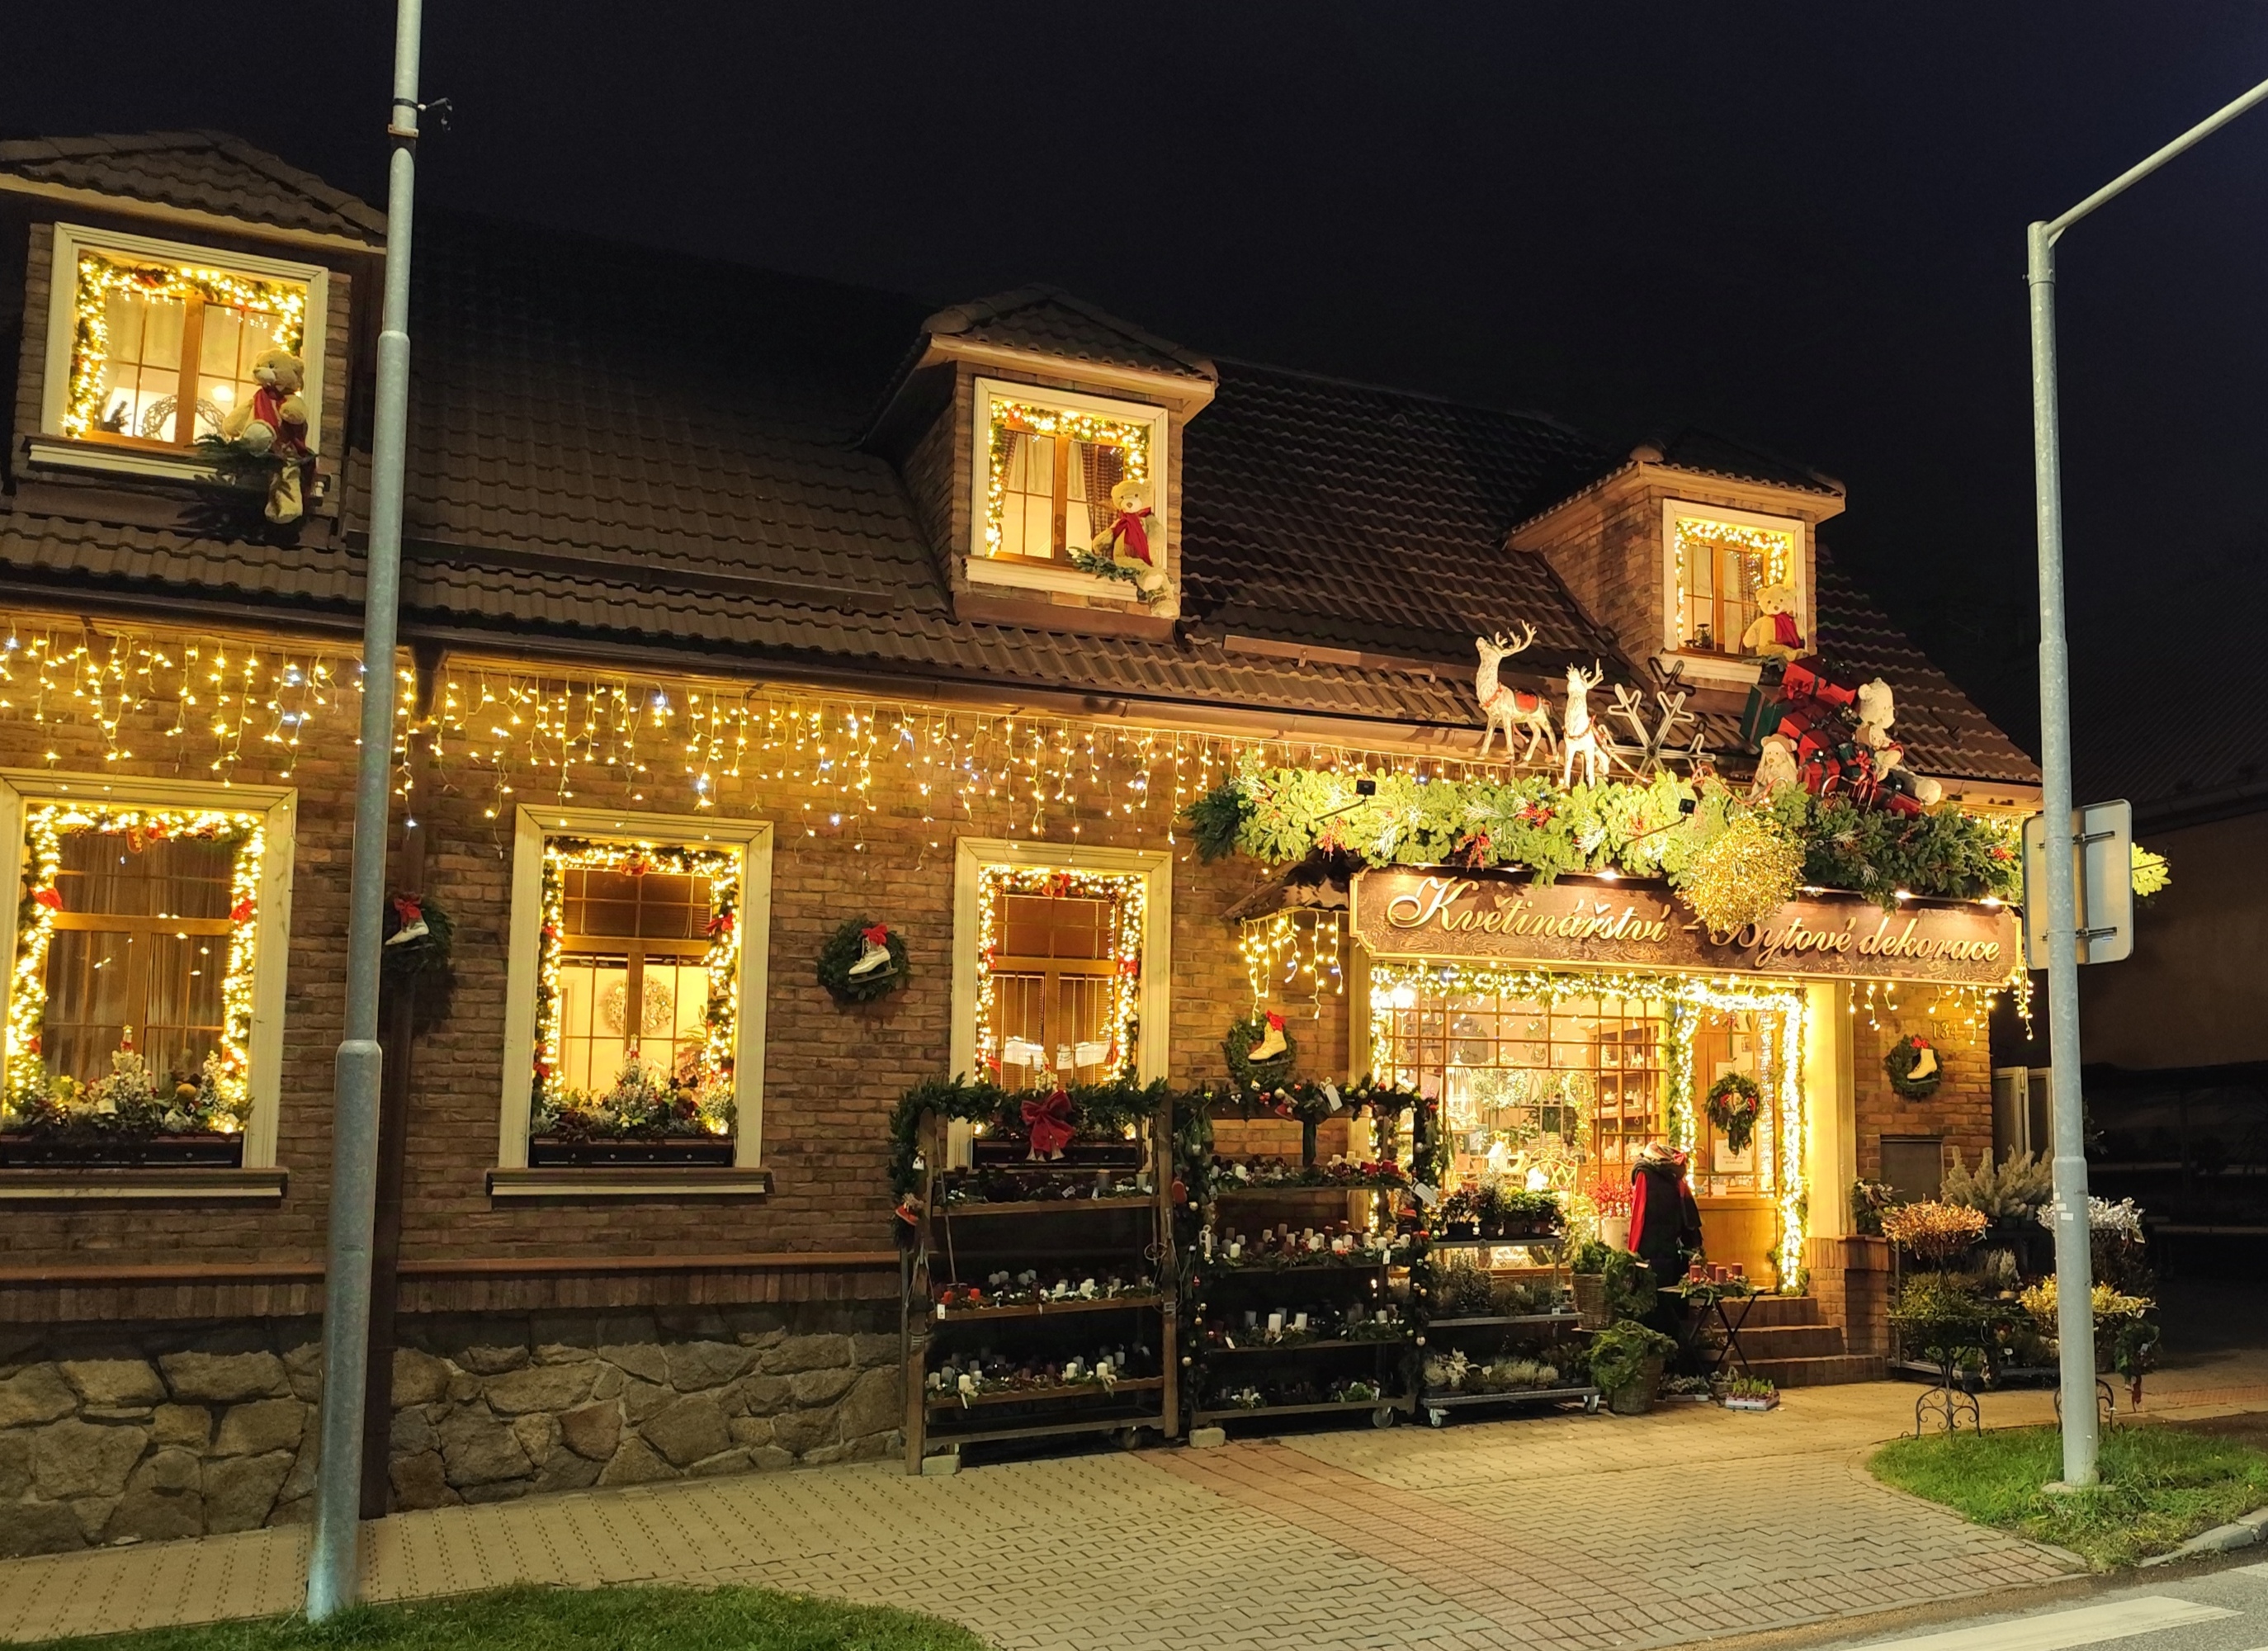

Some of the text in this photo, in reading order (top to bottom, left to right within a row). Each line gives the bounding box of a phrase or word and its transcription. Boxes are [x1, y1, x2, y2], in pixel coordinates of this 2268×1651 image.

[1387, 876, 1670, 943] Květinářství
[1858, 915, 2000, 961] dekorace
[1932, 1021, 1966, 1041] 134
